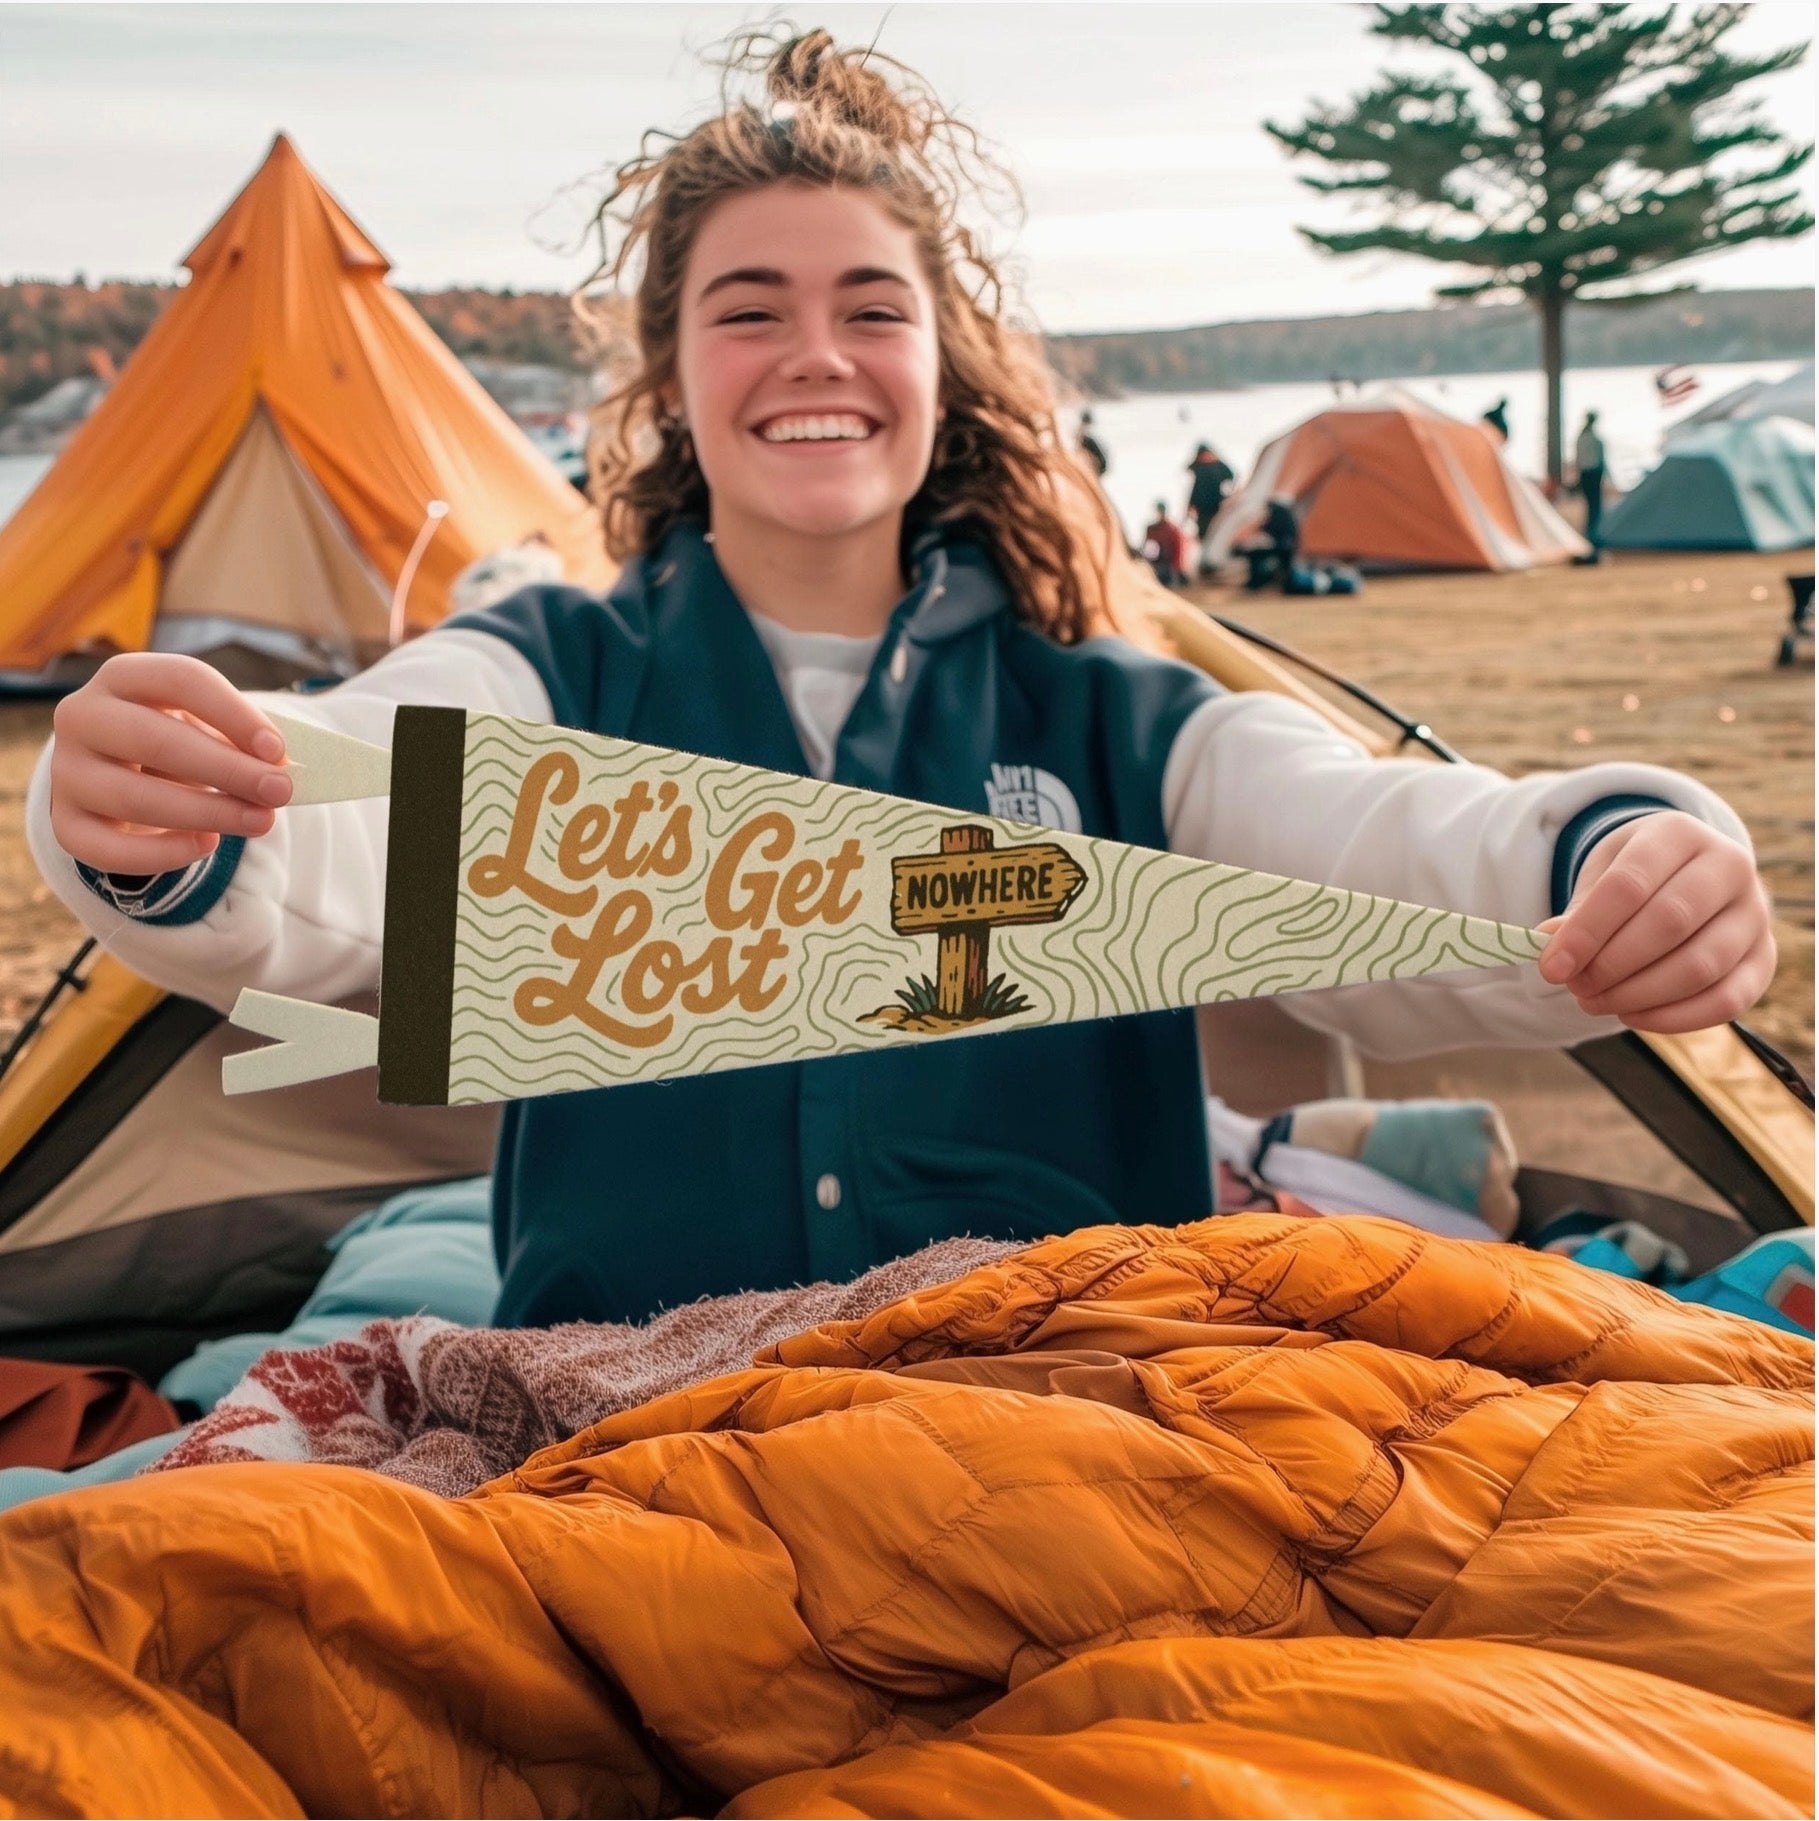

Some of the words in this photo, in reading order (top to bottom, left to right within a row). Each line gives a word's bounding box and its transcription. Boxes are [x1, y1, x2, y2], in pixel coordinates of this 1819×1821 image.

[467, 751, 693, 917] Let's
[704, 811, 865, 931] Get
[907, 862, 1055, 910] NOWHERE
[513, 889, 789, 1048] Lost
